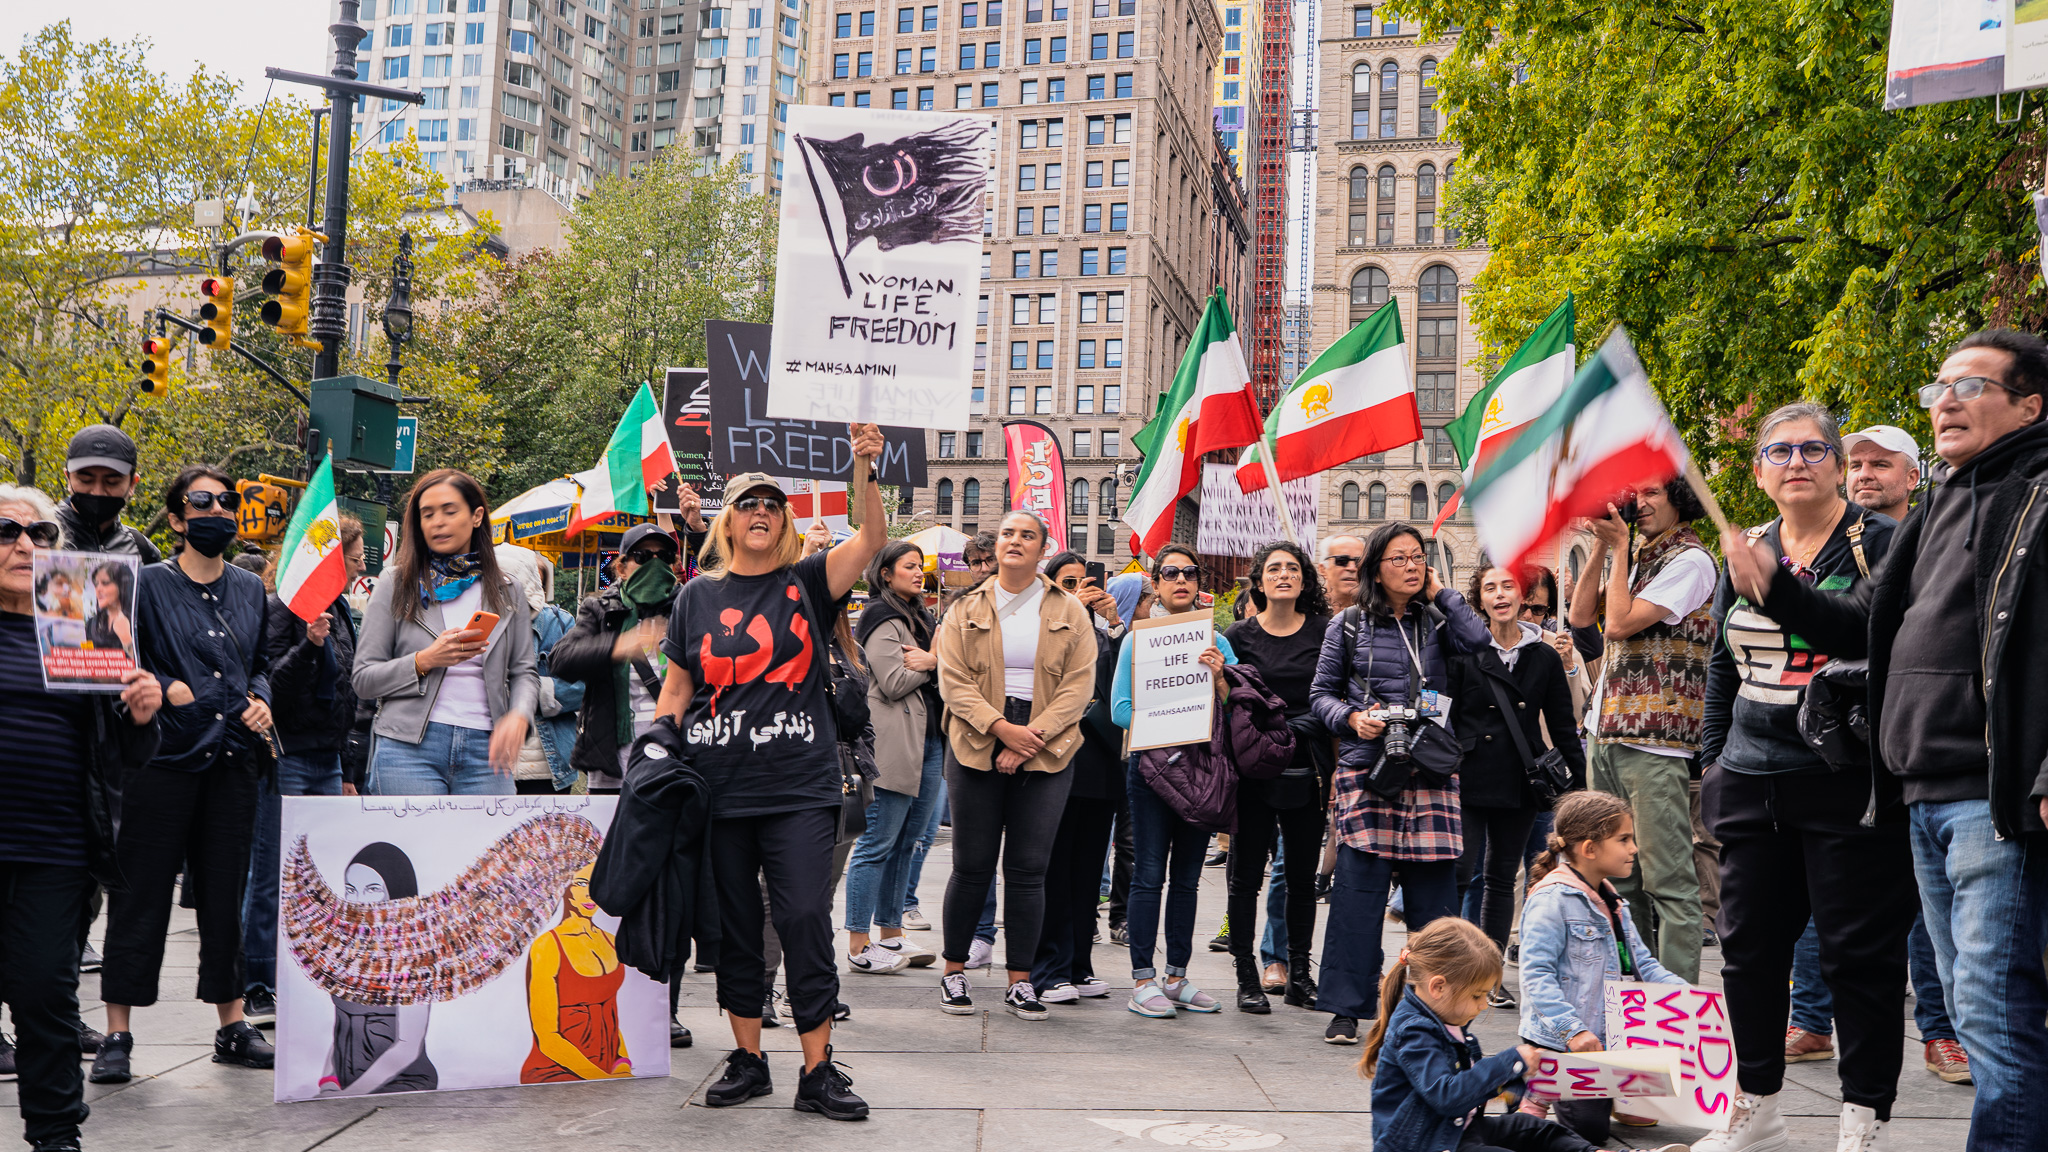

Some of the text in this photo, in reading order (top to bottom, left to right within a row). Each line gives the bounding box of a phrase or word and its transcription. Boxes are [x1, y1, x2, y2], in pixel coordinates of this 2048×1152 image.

[862, 149, 917, 196] زن
[858, 272, 962, 297] WOMAN,
[863, 292, 938, 317] LIFE,
[829, 315, 957, 350] FREEDOM
[727, 426, 911, 483] FREEDM
[671, 471, 707, 482] Fmmes,
[708, 472, 724, 482] Vie,
[1023, 440, 1054, 512] ICE
[1149, 630, 1205, 648] WOMAN
[1164, 653, 1189, 667] LIFE
[1145, 672, 1209, 691] FREEDOM
[1148, 703, 1206, 718] #MAHSAAMINI
[687, 709, 815, 752] زندگی آزادی
